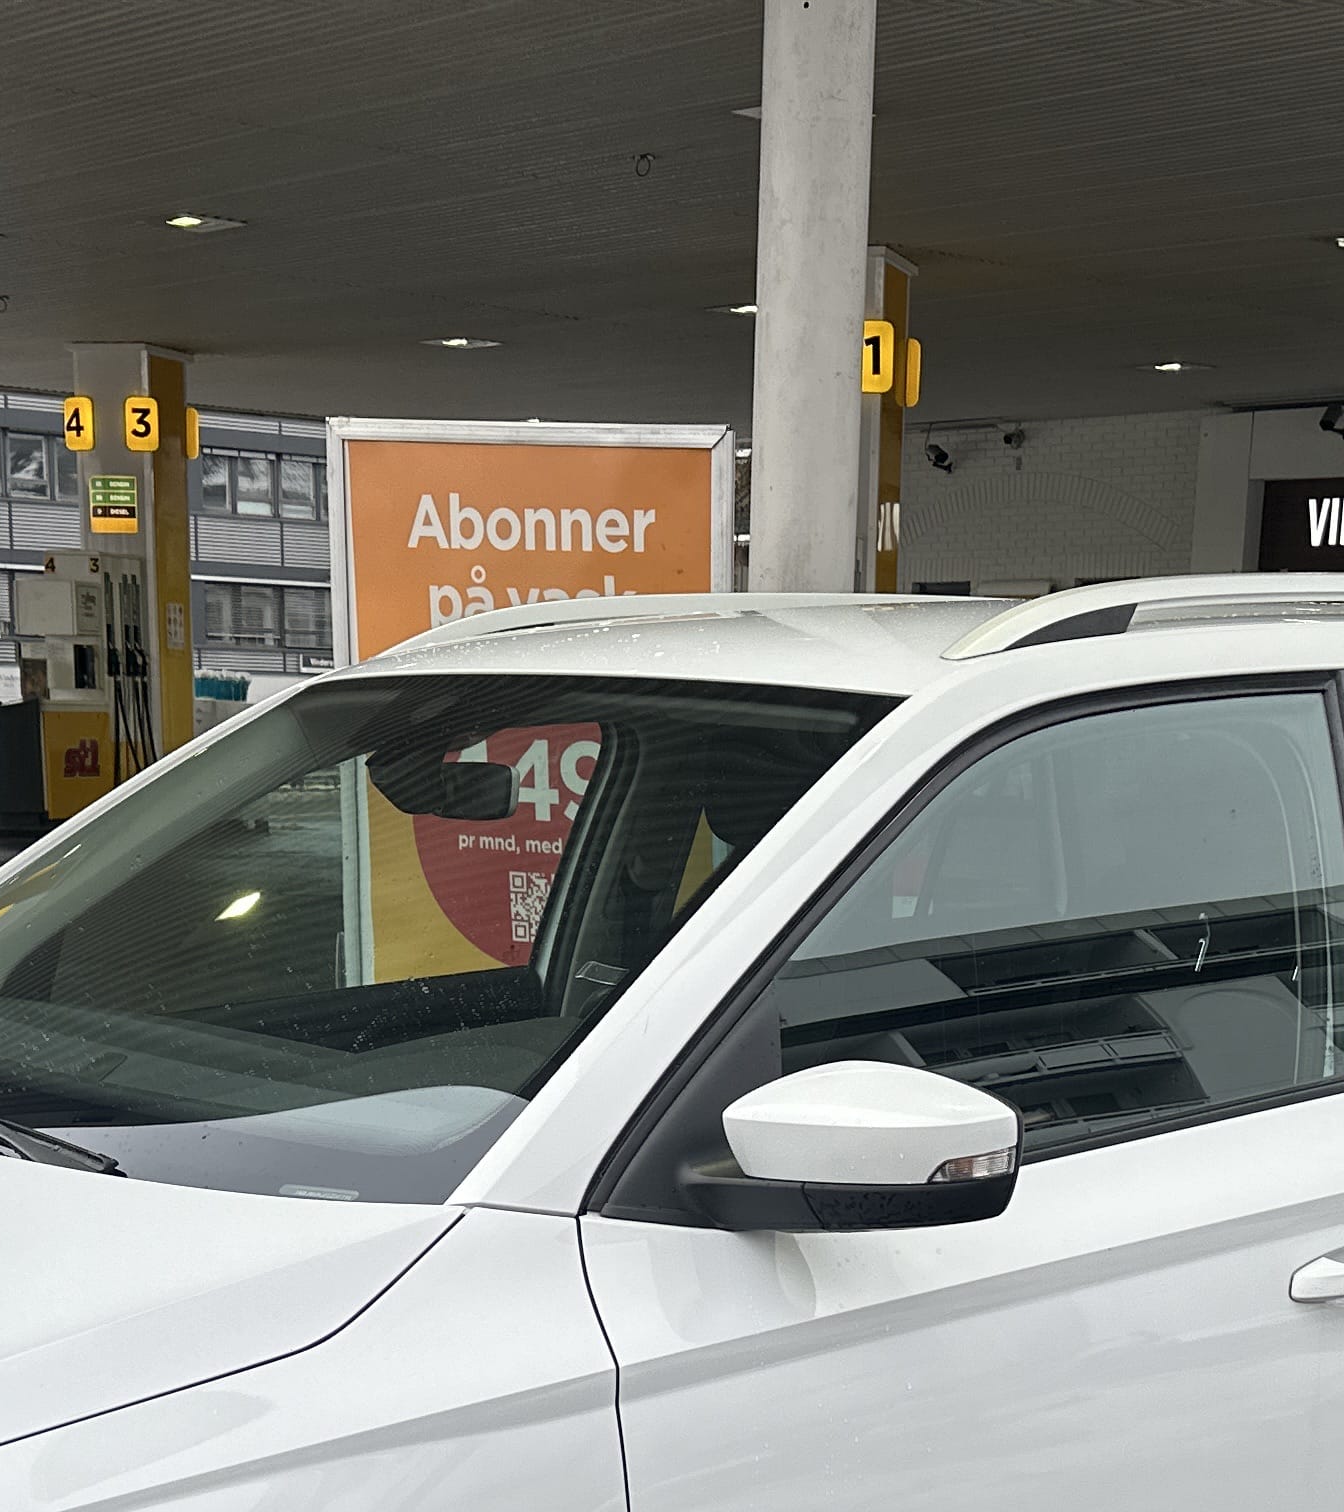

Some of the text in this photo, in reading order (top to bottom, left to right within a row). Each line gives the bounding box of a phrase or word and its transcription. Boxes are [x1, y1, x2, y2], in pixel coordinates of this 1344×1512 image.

[864, 335, 881, 375] 1
[66, 407, 85, 437] 4
[130, 407, 152, 438] 3
[407, 492, 656, 553] Abonner
[44, 557, 56, 573] 4
[89, 557, 100, 573] 3
[429, 565, 495, 628] på
[458, 738, 602, 822] 49
[458, 835, 563, 855] pr mnd, med
